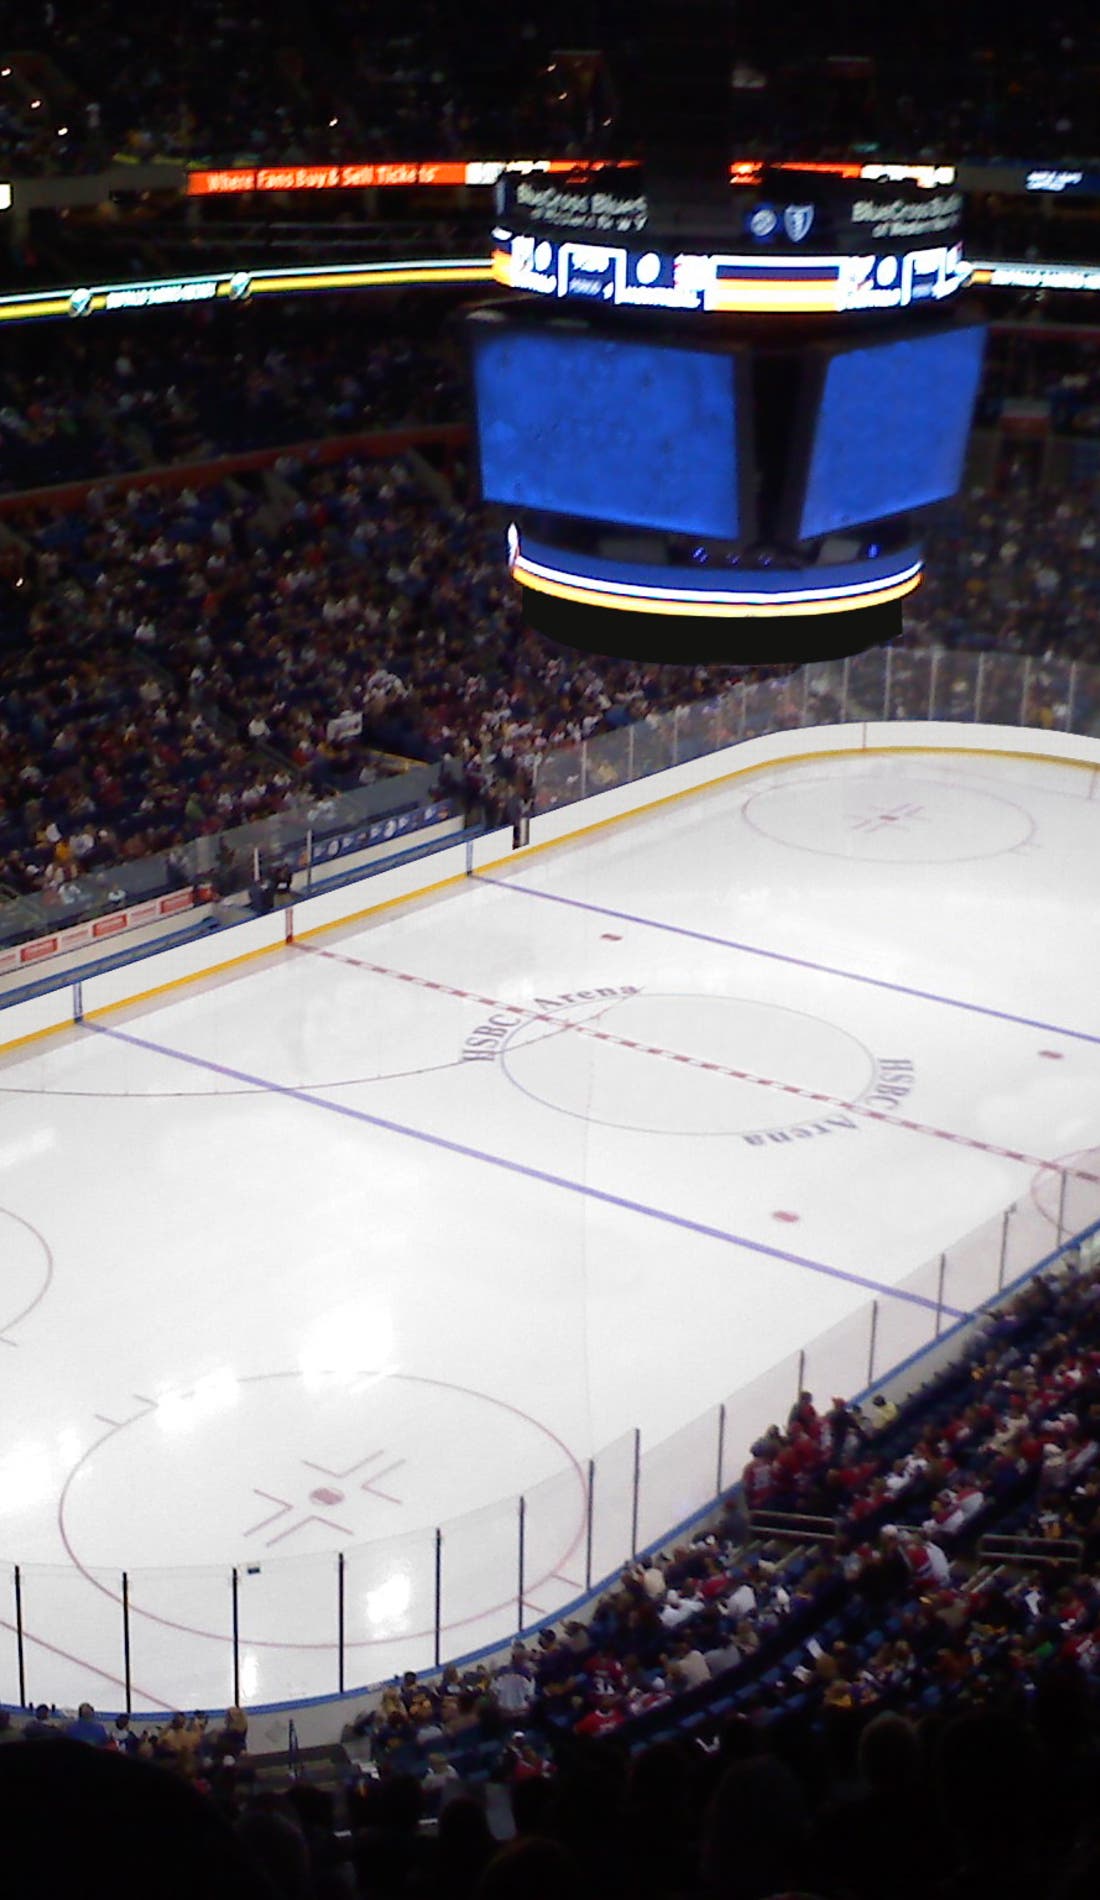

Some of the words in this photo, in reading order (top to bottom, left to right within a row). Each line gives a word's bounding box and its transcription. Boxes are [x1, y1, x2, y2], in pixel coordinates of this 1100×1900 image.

[462, 1014, 521, 1062] HSBC
[533, 984, 639, 1012] Arena
[866, 1057, 915, 1110] HSBC
[742, 1112, 858, 1147] Arena
